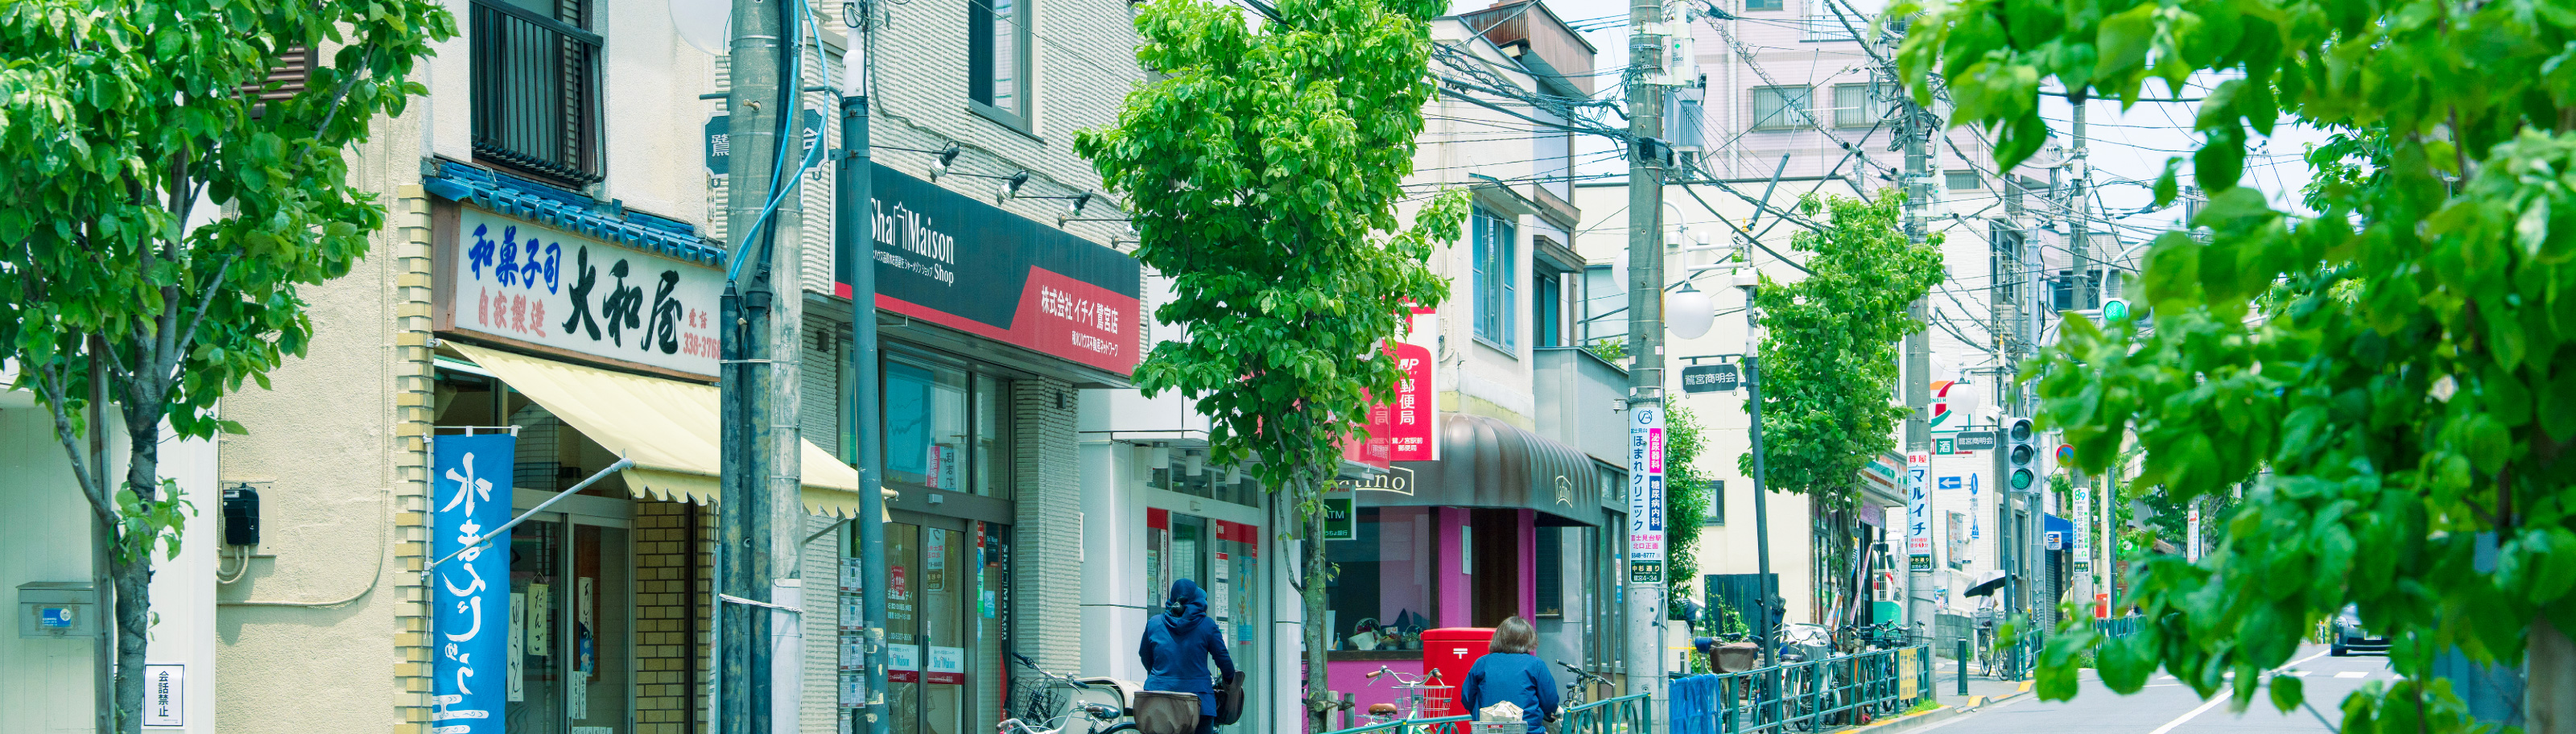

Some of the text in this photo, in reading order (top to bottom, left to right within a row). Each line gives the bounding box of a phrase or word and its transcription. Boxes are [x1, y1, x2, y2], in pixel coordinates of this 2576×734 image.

[469, 223, 561, 295] 和菓子司
[908, 210, 955, 266] Maison
[934, 263, 954, 287] Shop
[478, 285, 547, 338] 自家製造
[562, 245, 683, 355] 大和屋
[1041, 284, 1118, 335] 株式会社 イチイ 鷺宮店
[1399, 378, 1415, 425] 郵便局
[1685, 372, 1736, 386] 鷺宮商明会
[1651, 433, 1661, 469] 泌尿器科
[1909, 455, 1927, 464] 質屋
[1939, 440, 1951, 453] 酒
[1959, 437, 1994, 445] 鷺宮商明会
[1633, 435, 1644, 532] ほまれクリニック
[1651, 480, 1661, 526] 糖尿病内科
[1911, 469, 1926, 536] マルイチ
[440, 452, 493, 695] 水まんじゅう
[158, 670, 169, 717] 会話禁止
